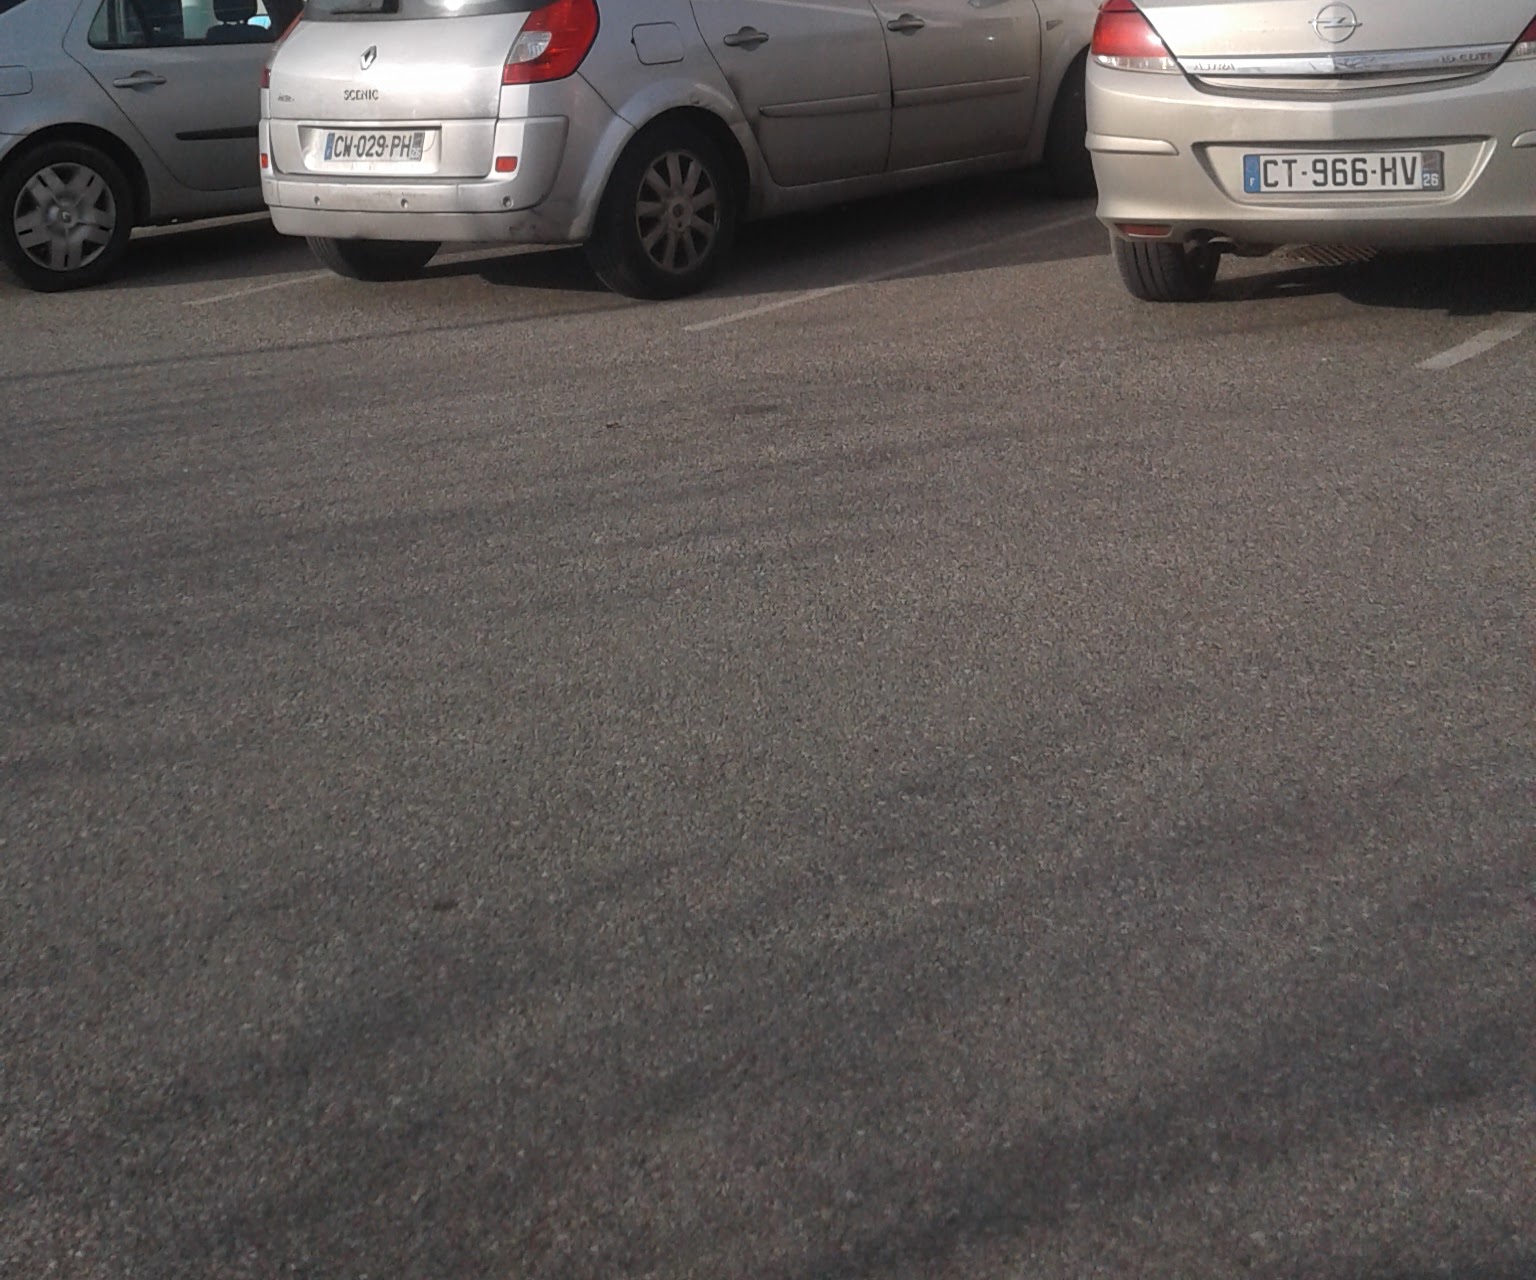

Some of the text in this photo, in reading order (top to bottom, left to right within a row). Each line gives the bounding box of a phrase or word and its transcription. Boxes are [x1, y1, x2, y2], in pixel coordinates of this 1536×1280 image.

[333, 134, 412, 158] CW-029-PH
[1262, 156, 1418, 188] CT-966-HV
[1422, 173, 1440, 187] 26
